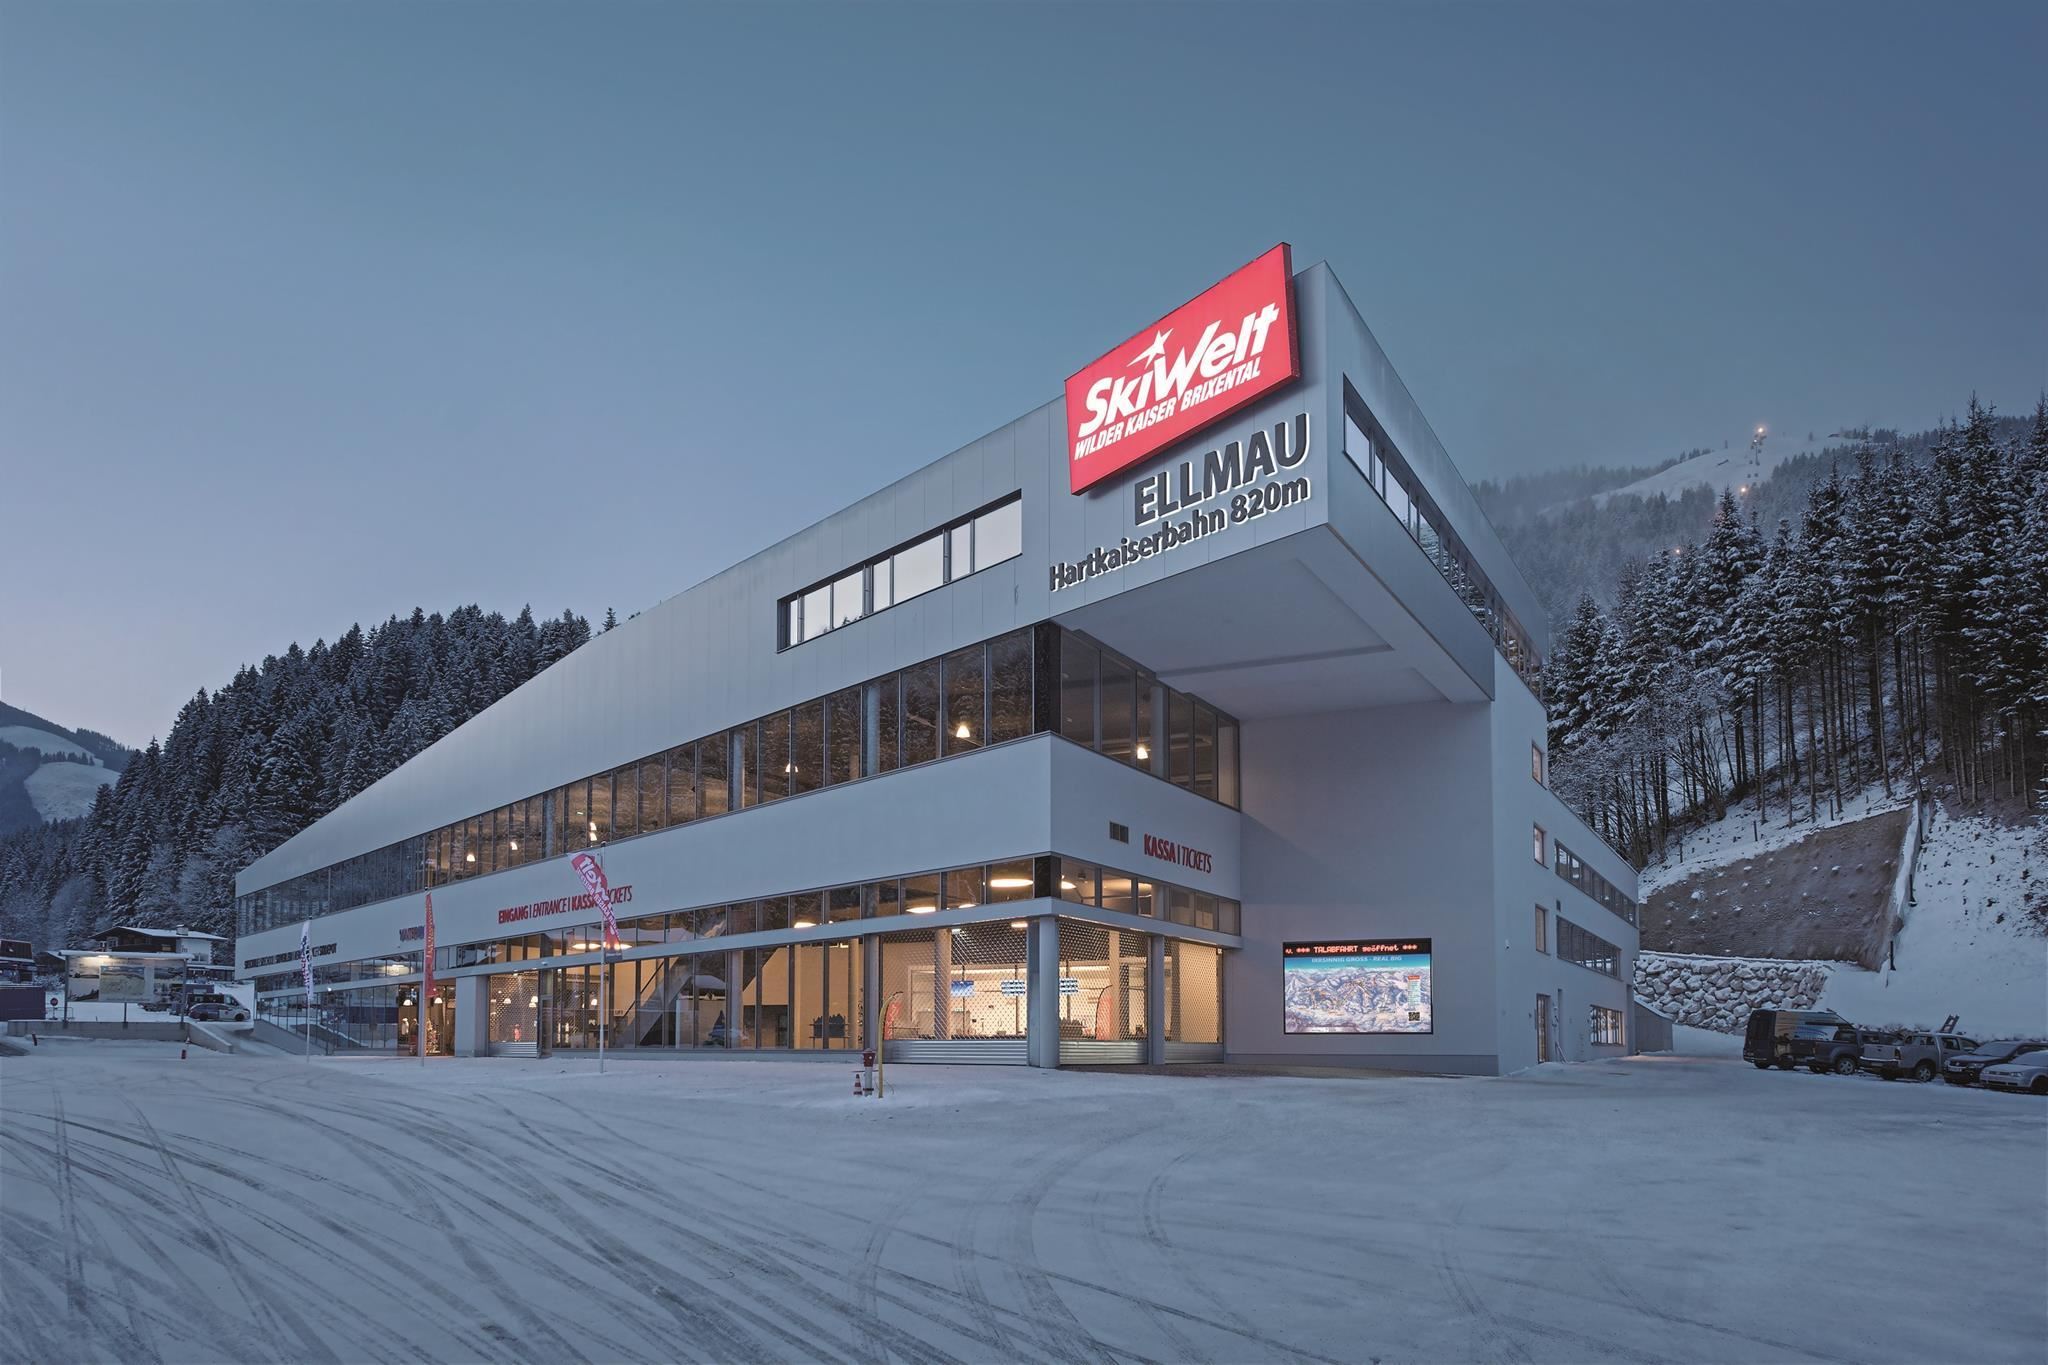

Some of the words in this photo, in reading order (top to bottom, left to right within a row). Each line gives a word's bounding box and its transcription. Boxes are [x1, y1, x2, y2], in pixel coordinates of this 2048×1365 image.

[1074, 422, 1123, 461] WILDER
[1124, 397, 1177, 438] KAISER
[1180, 357, 1261, 413] BRIXENTAL
[1077, 302, 1280, 438] SkiWelt
[1134, 413, 1310, 526] ELLMAU
[1049, 505, 1226, 592] Hartkaiserbahn
[1230, 476, 1310, 524] 820m
[1143, 833, 1176, 863] KASSA
[1182, 846, 1212, 873] TICKETS
[498, 904, 529, 924] EINGANG
[533, 897, 567, 918] ENTRANCE
[1313, 945, 1358, 954] TALABFAHRT
